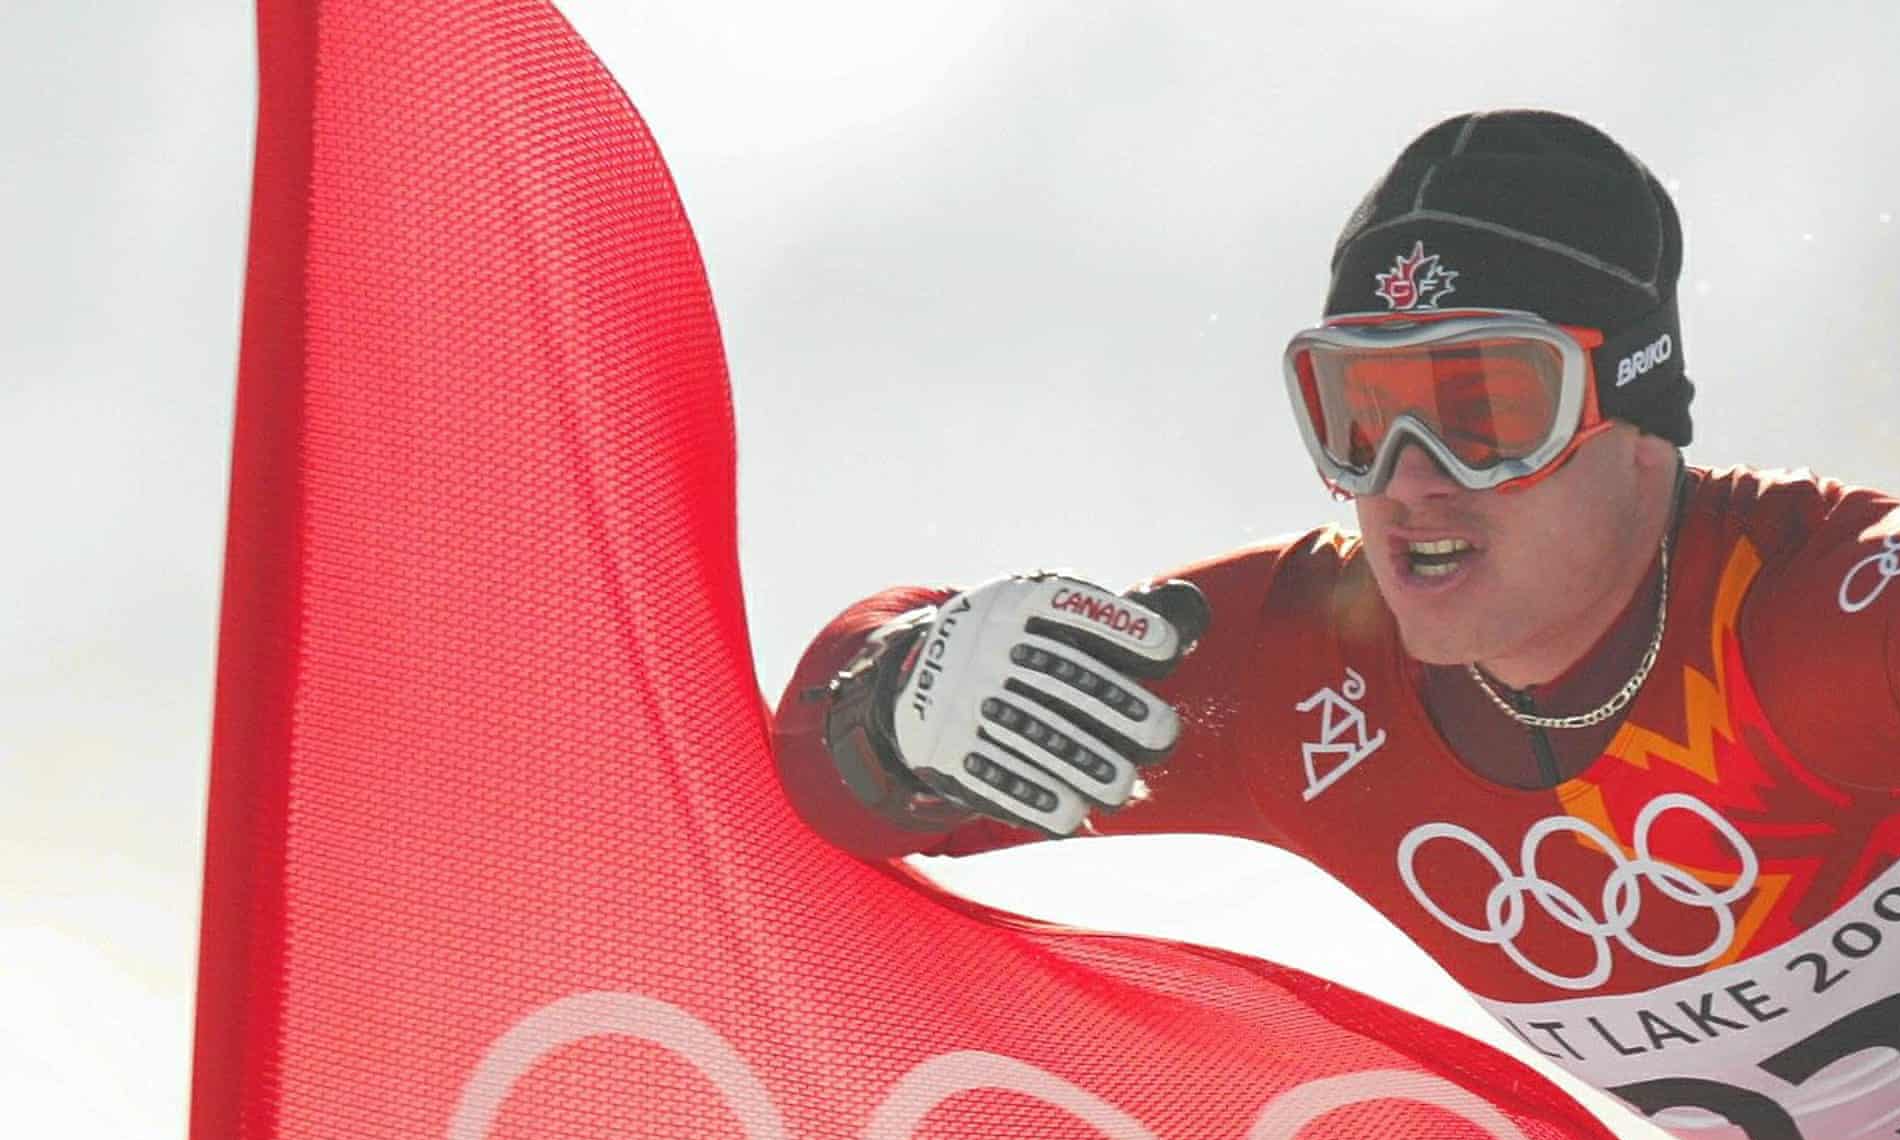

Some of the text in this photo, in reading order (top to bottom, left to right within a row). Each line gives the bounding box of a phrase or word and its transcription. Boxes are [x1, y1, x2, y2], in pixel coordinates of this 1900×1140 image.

[1615, 333, 1673, 387] BRIKO
[1050, 588, 1150, 642] CANADA
[911, 597, 971, 721] Auclair
[1587, 979, 1789, 1056] LAKE
